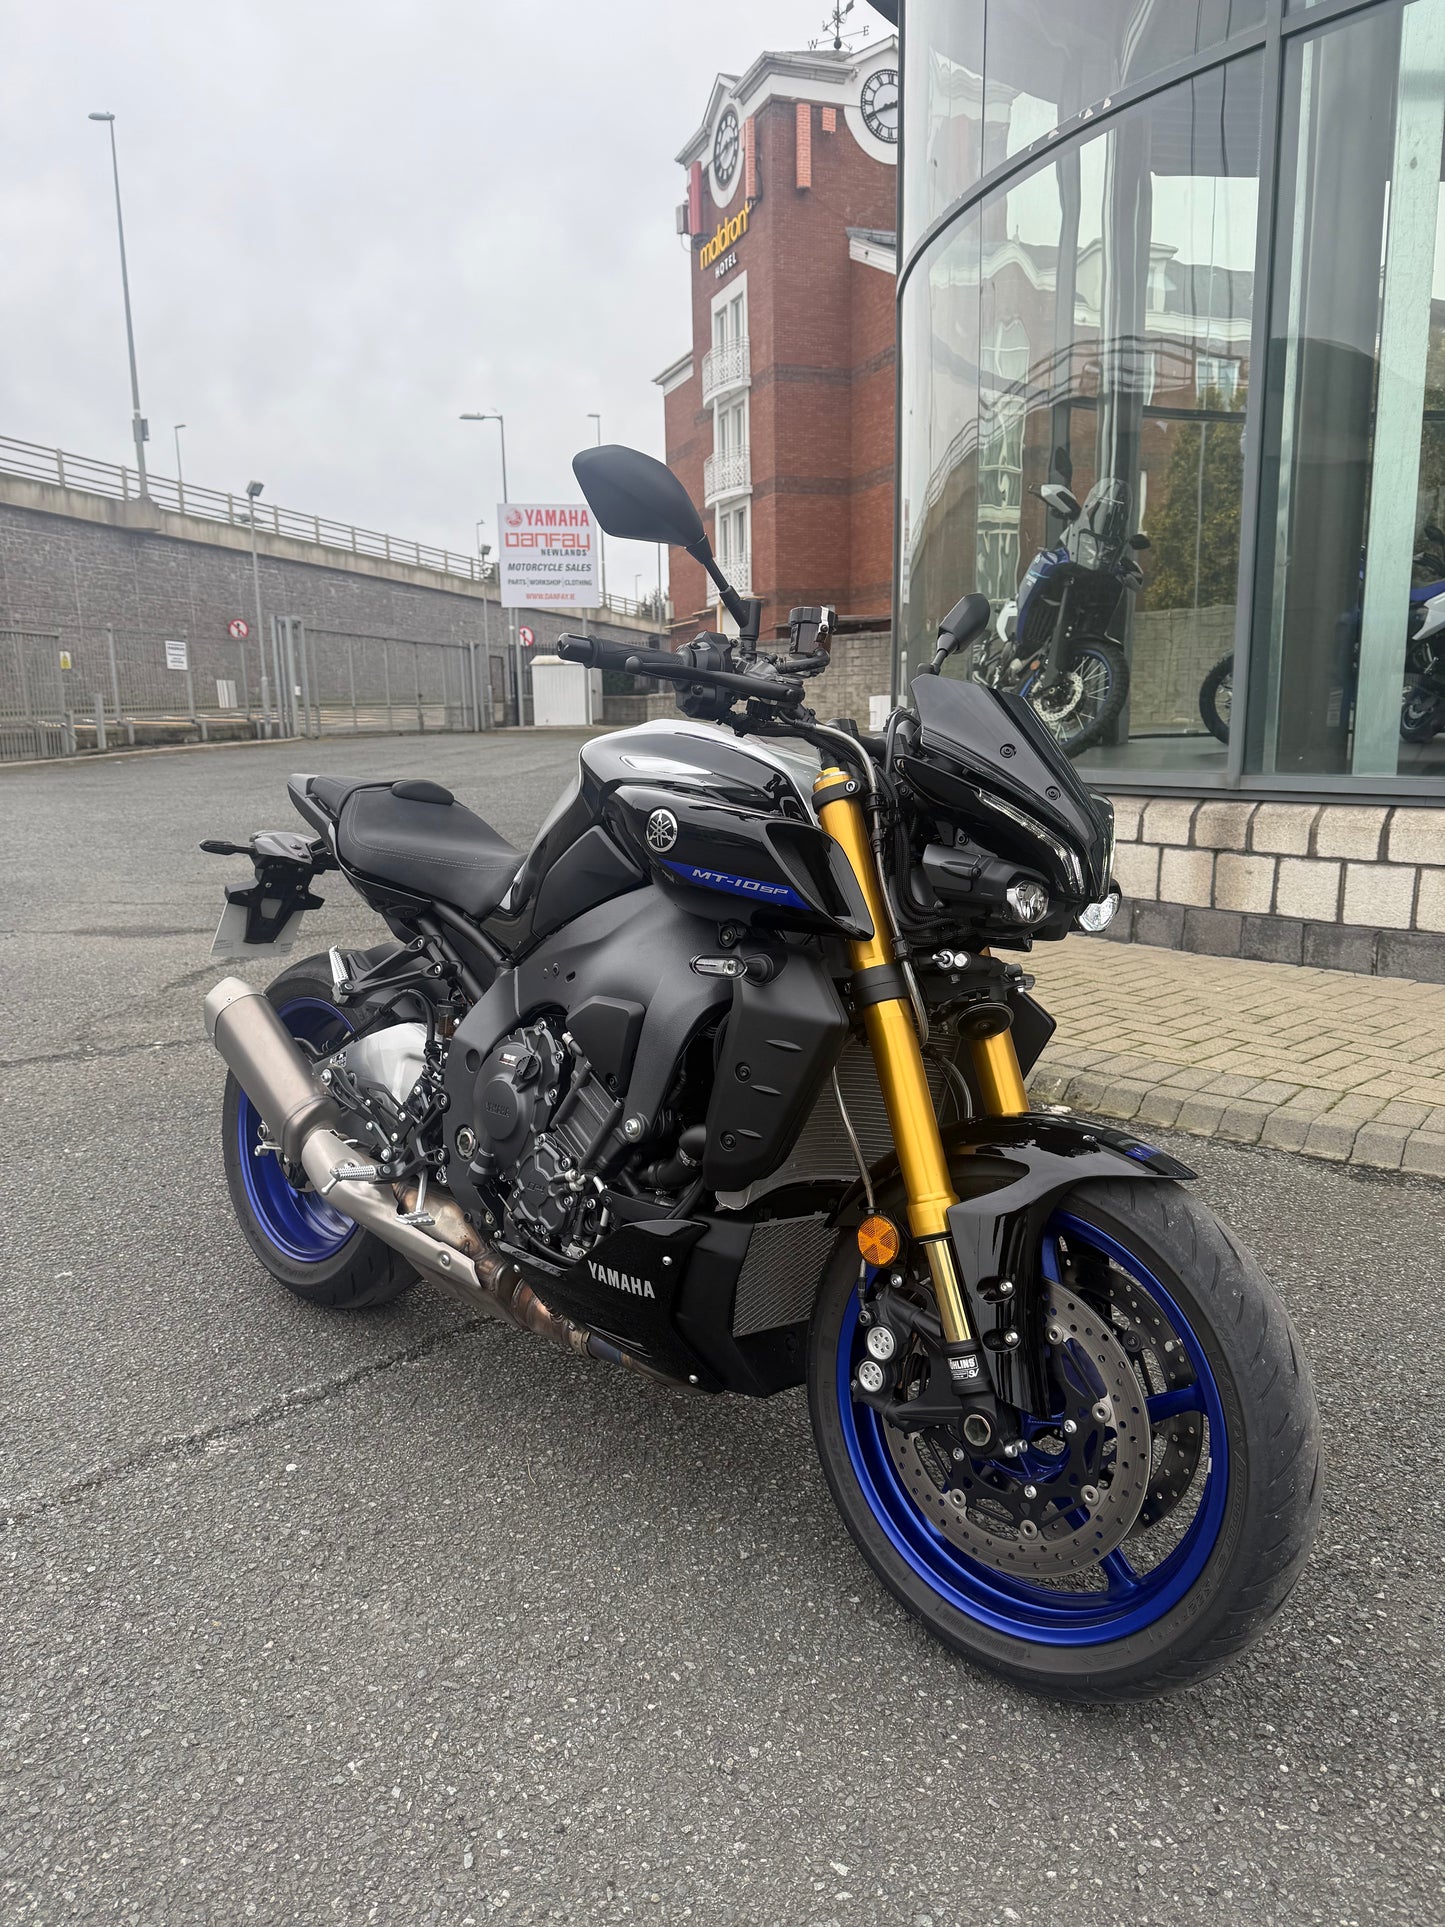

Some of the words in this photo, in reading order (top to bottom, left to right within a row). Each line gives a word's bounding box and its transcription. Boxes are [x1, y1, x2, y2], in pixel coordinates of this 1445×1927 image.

[808, 38, 818, 51] W
[700, 209, 747, 271] maldron
[714, 251, 737, 279] HOTEL
[524, 509, 590, 526] YAMAHA
[507, 562, 563, 572] MOTORCYCLE
[565, 563, 592, 572] SALES
[587, 1259, 656, 1300] YAMAHA
